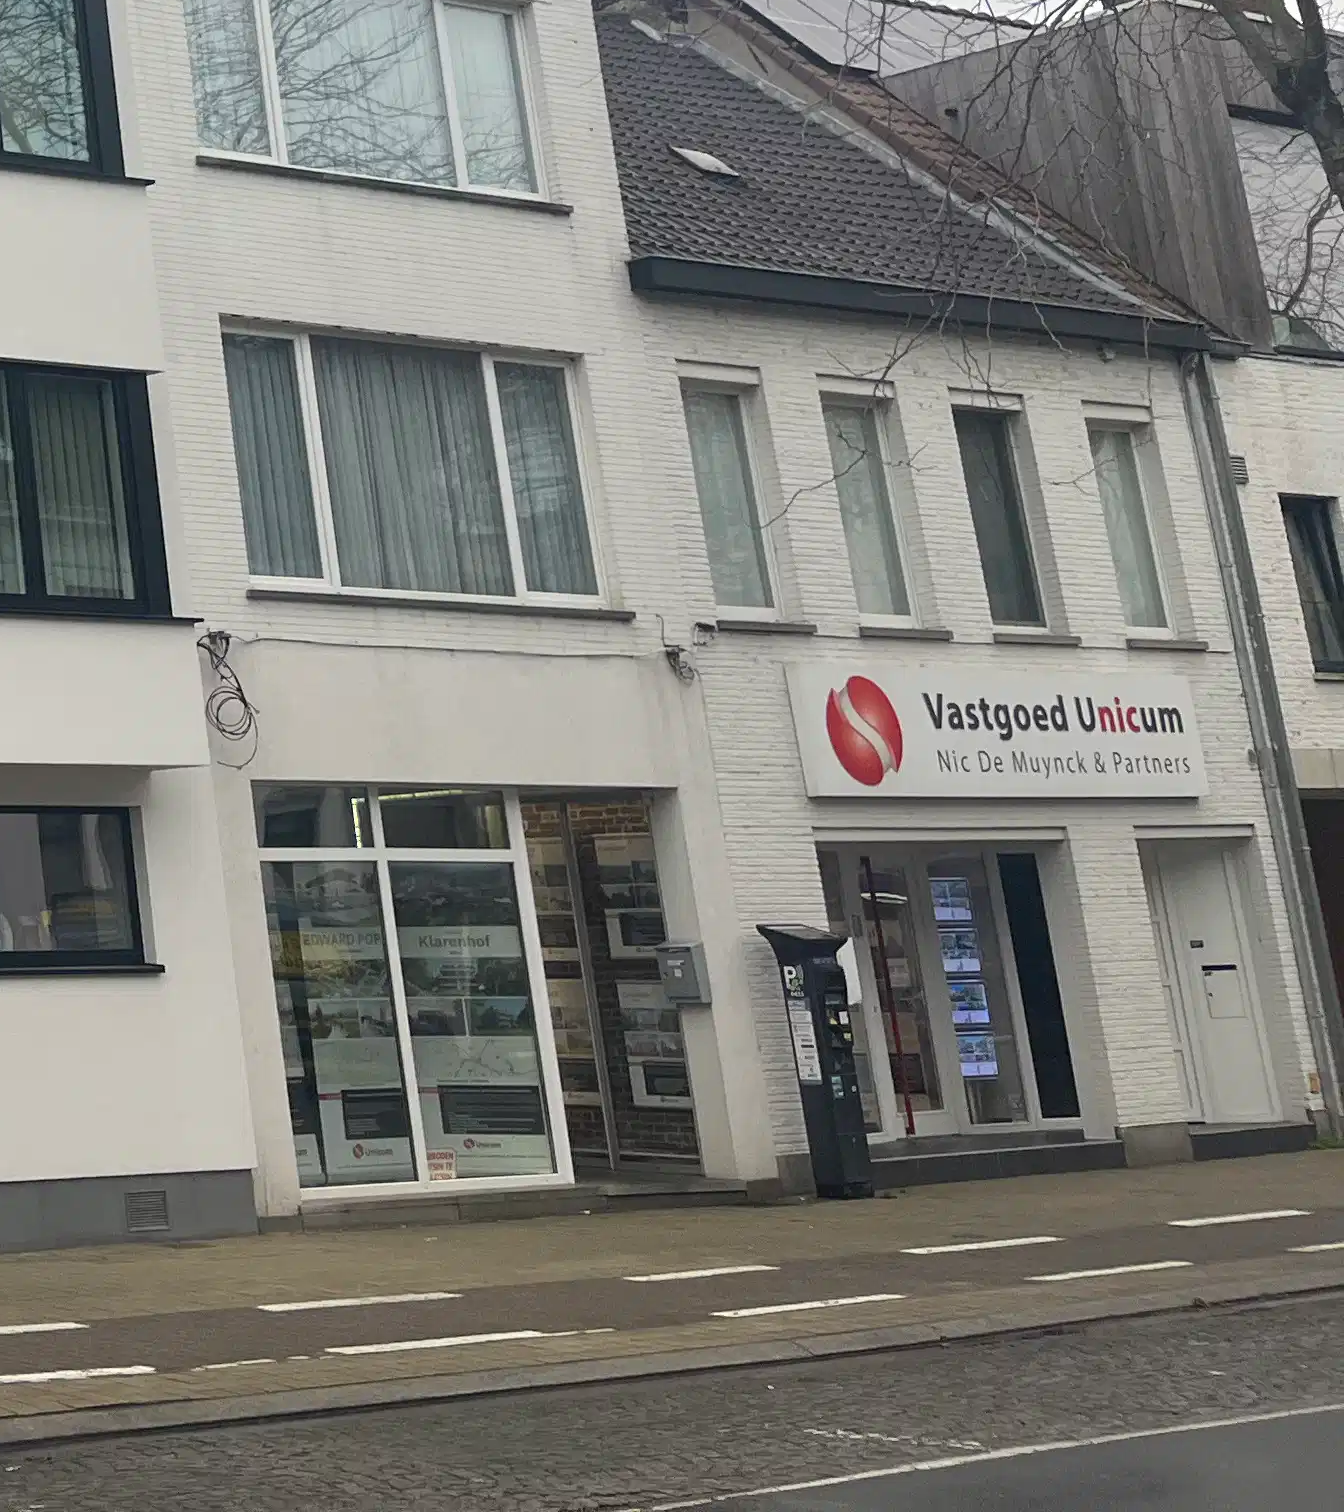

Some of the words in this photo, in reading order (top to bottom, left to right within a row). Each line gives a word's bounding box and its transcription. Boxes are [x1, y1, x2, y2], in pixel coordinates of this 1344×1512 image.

[922, 692, 1068, 741] Vastgoed
[1075, 696, 1184, 734] Unicum
[937, 749, 970, 774] Nic
[978, 750, 1004, 774] De
[1012, 750, 1087, 780] Muynck
[1095, 752, 1107, 774] &
[1114, 752, 1192, 775] Partners
[303, 932, 354, 946] EDWARD
[358, 932, 381, 946] POP
[418, 934, 491, 949] Klarenhof
